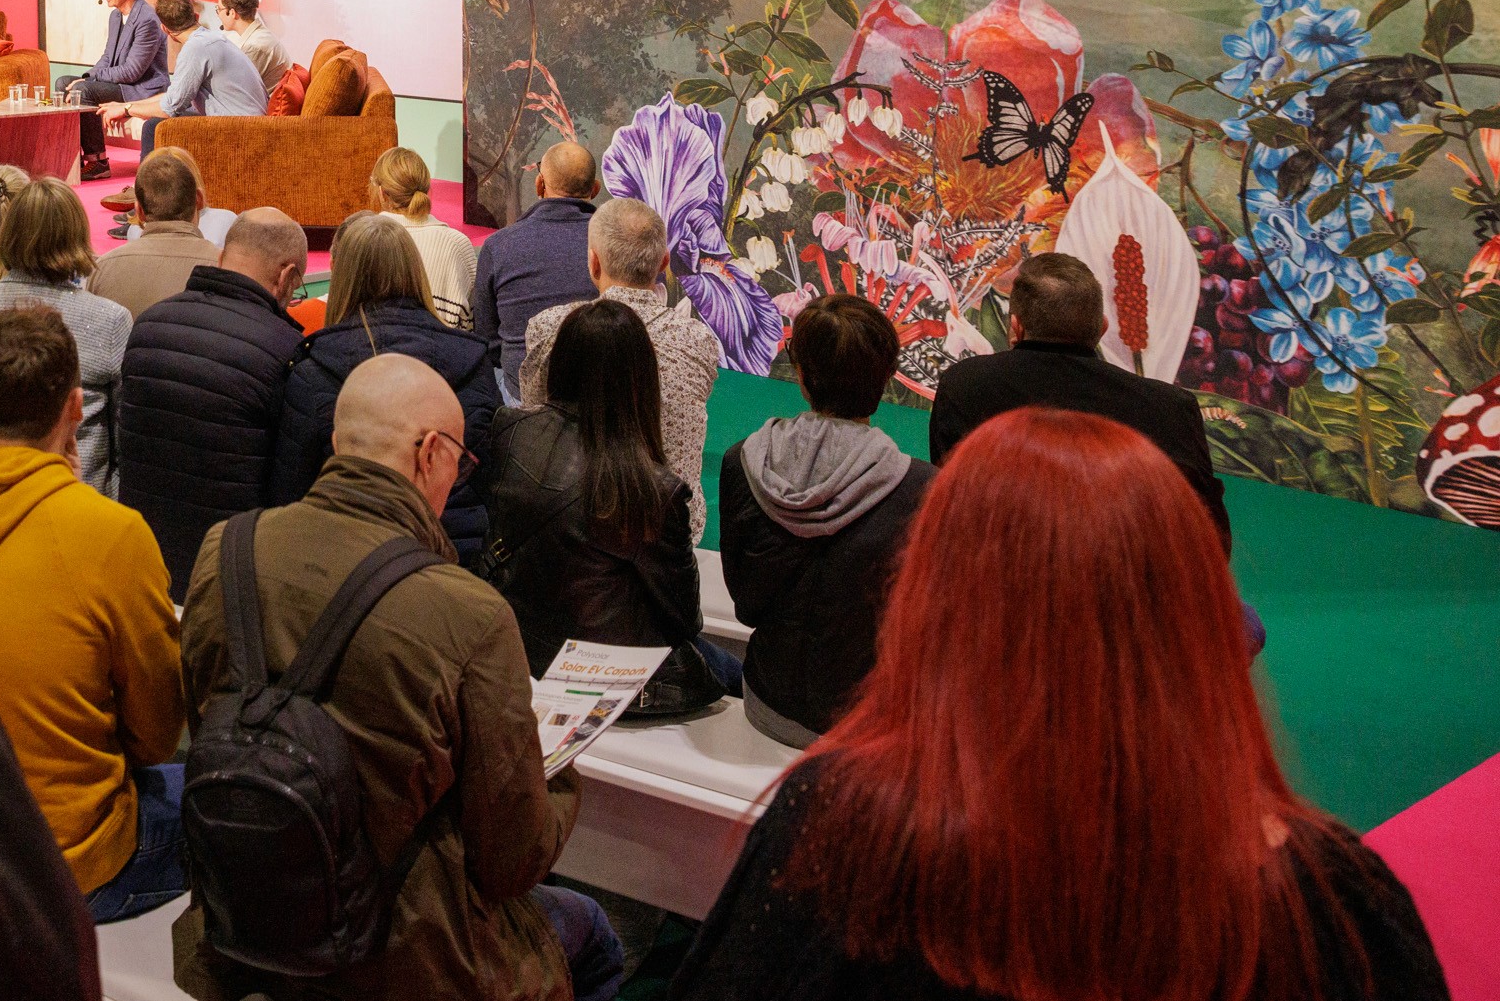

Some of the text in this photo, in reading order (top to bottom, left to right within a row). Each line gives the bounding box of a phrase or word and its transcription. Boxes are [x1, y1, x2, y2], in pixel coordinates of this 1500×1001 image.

[577, 649, 610, 660] Polysolar
[560, 661, 648, 677] Solar EV Carports
